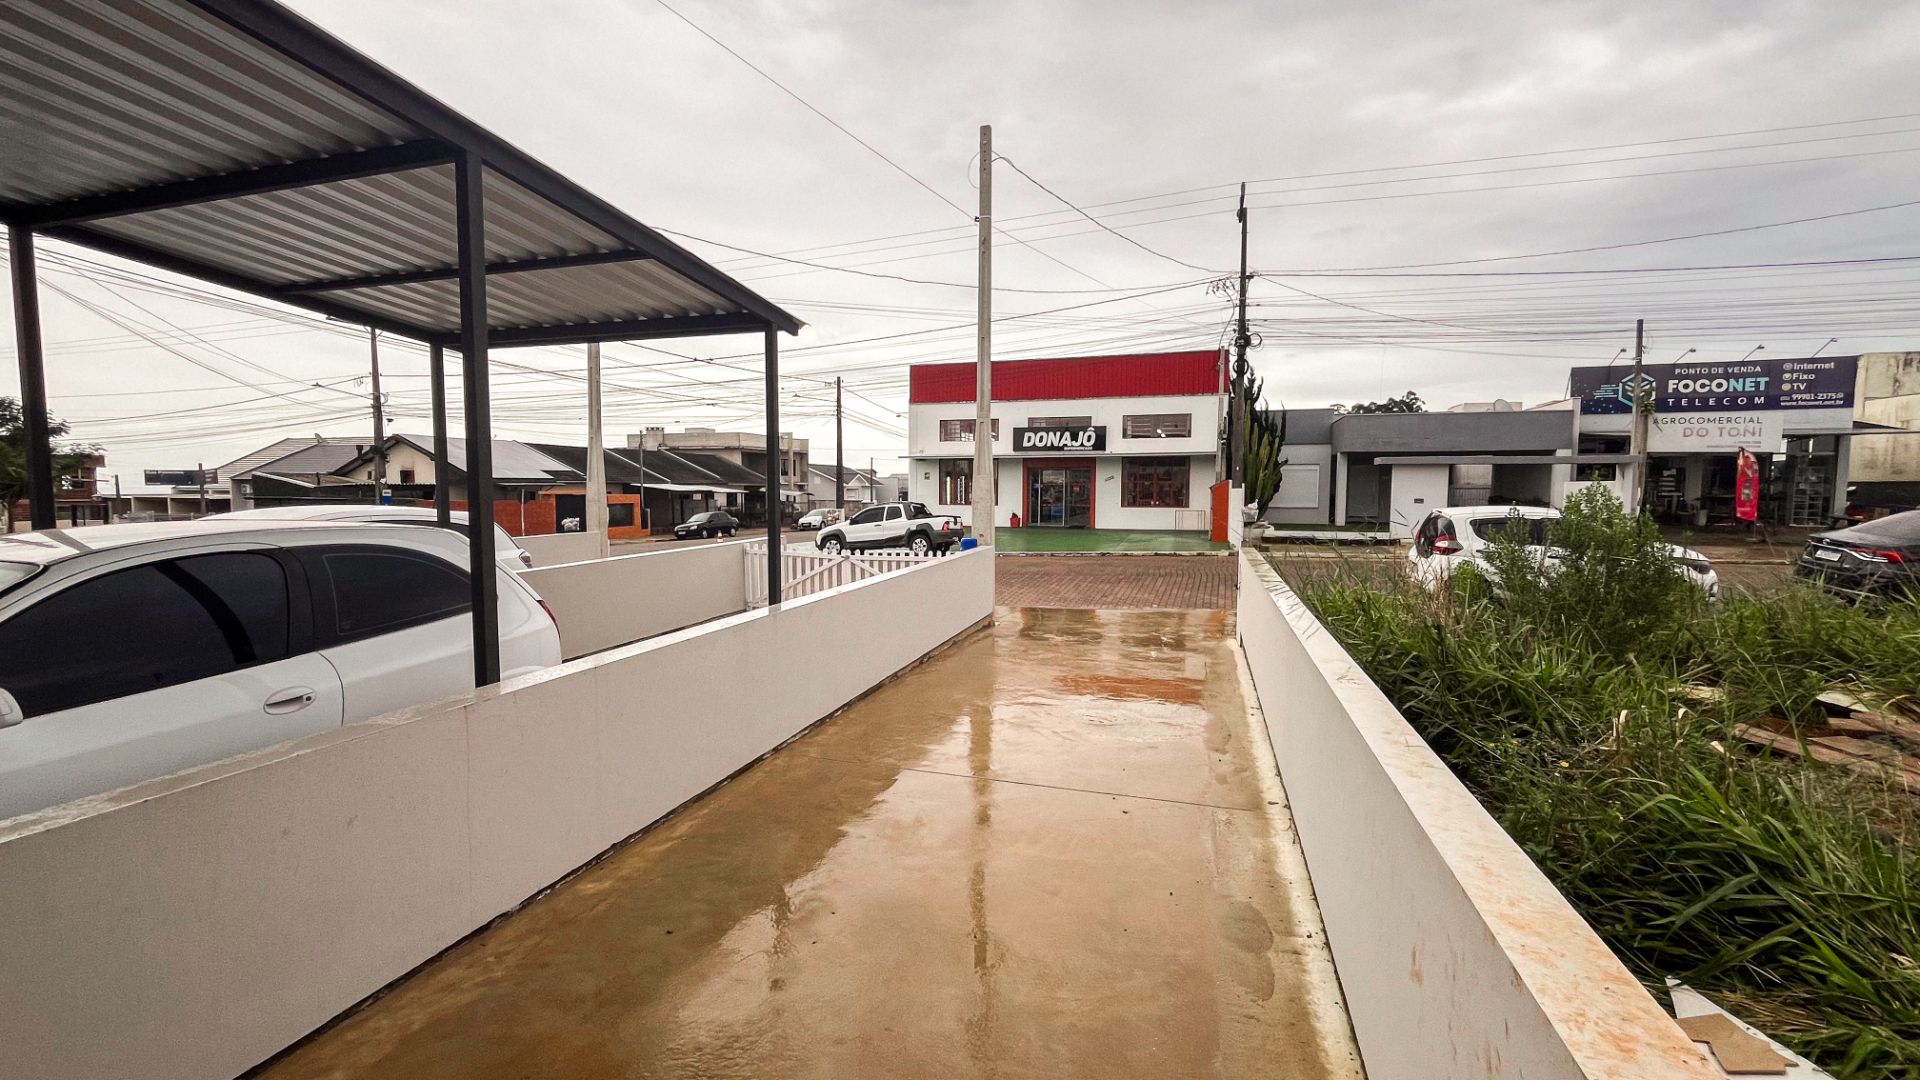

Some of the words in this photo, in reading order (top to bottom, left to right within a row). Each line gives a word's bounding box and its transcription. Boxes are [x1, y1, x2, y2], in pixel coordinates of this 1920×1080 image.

[1675, 367, 1708, 375] PONTO
[1711, 366, 1724, 374] DE
[1794, 362, 1835, 370] Internet
[1792, 372, 1815, 380] Fixo
[1668, 377, 1769, 393] FOCONET
[1792, 382, 1806, 390] TV
[1667, 397, 1764, 406] TELECOM
[1653, 416, 1762, 425] AGROCOMERCIAL
[1682, 427, 1709, 438] DO
[1718, 426, 1762, 437] TONI
[1022, 426, 1096, 448] DONAJÔ
